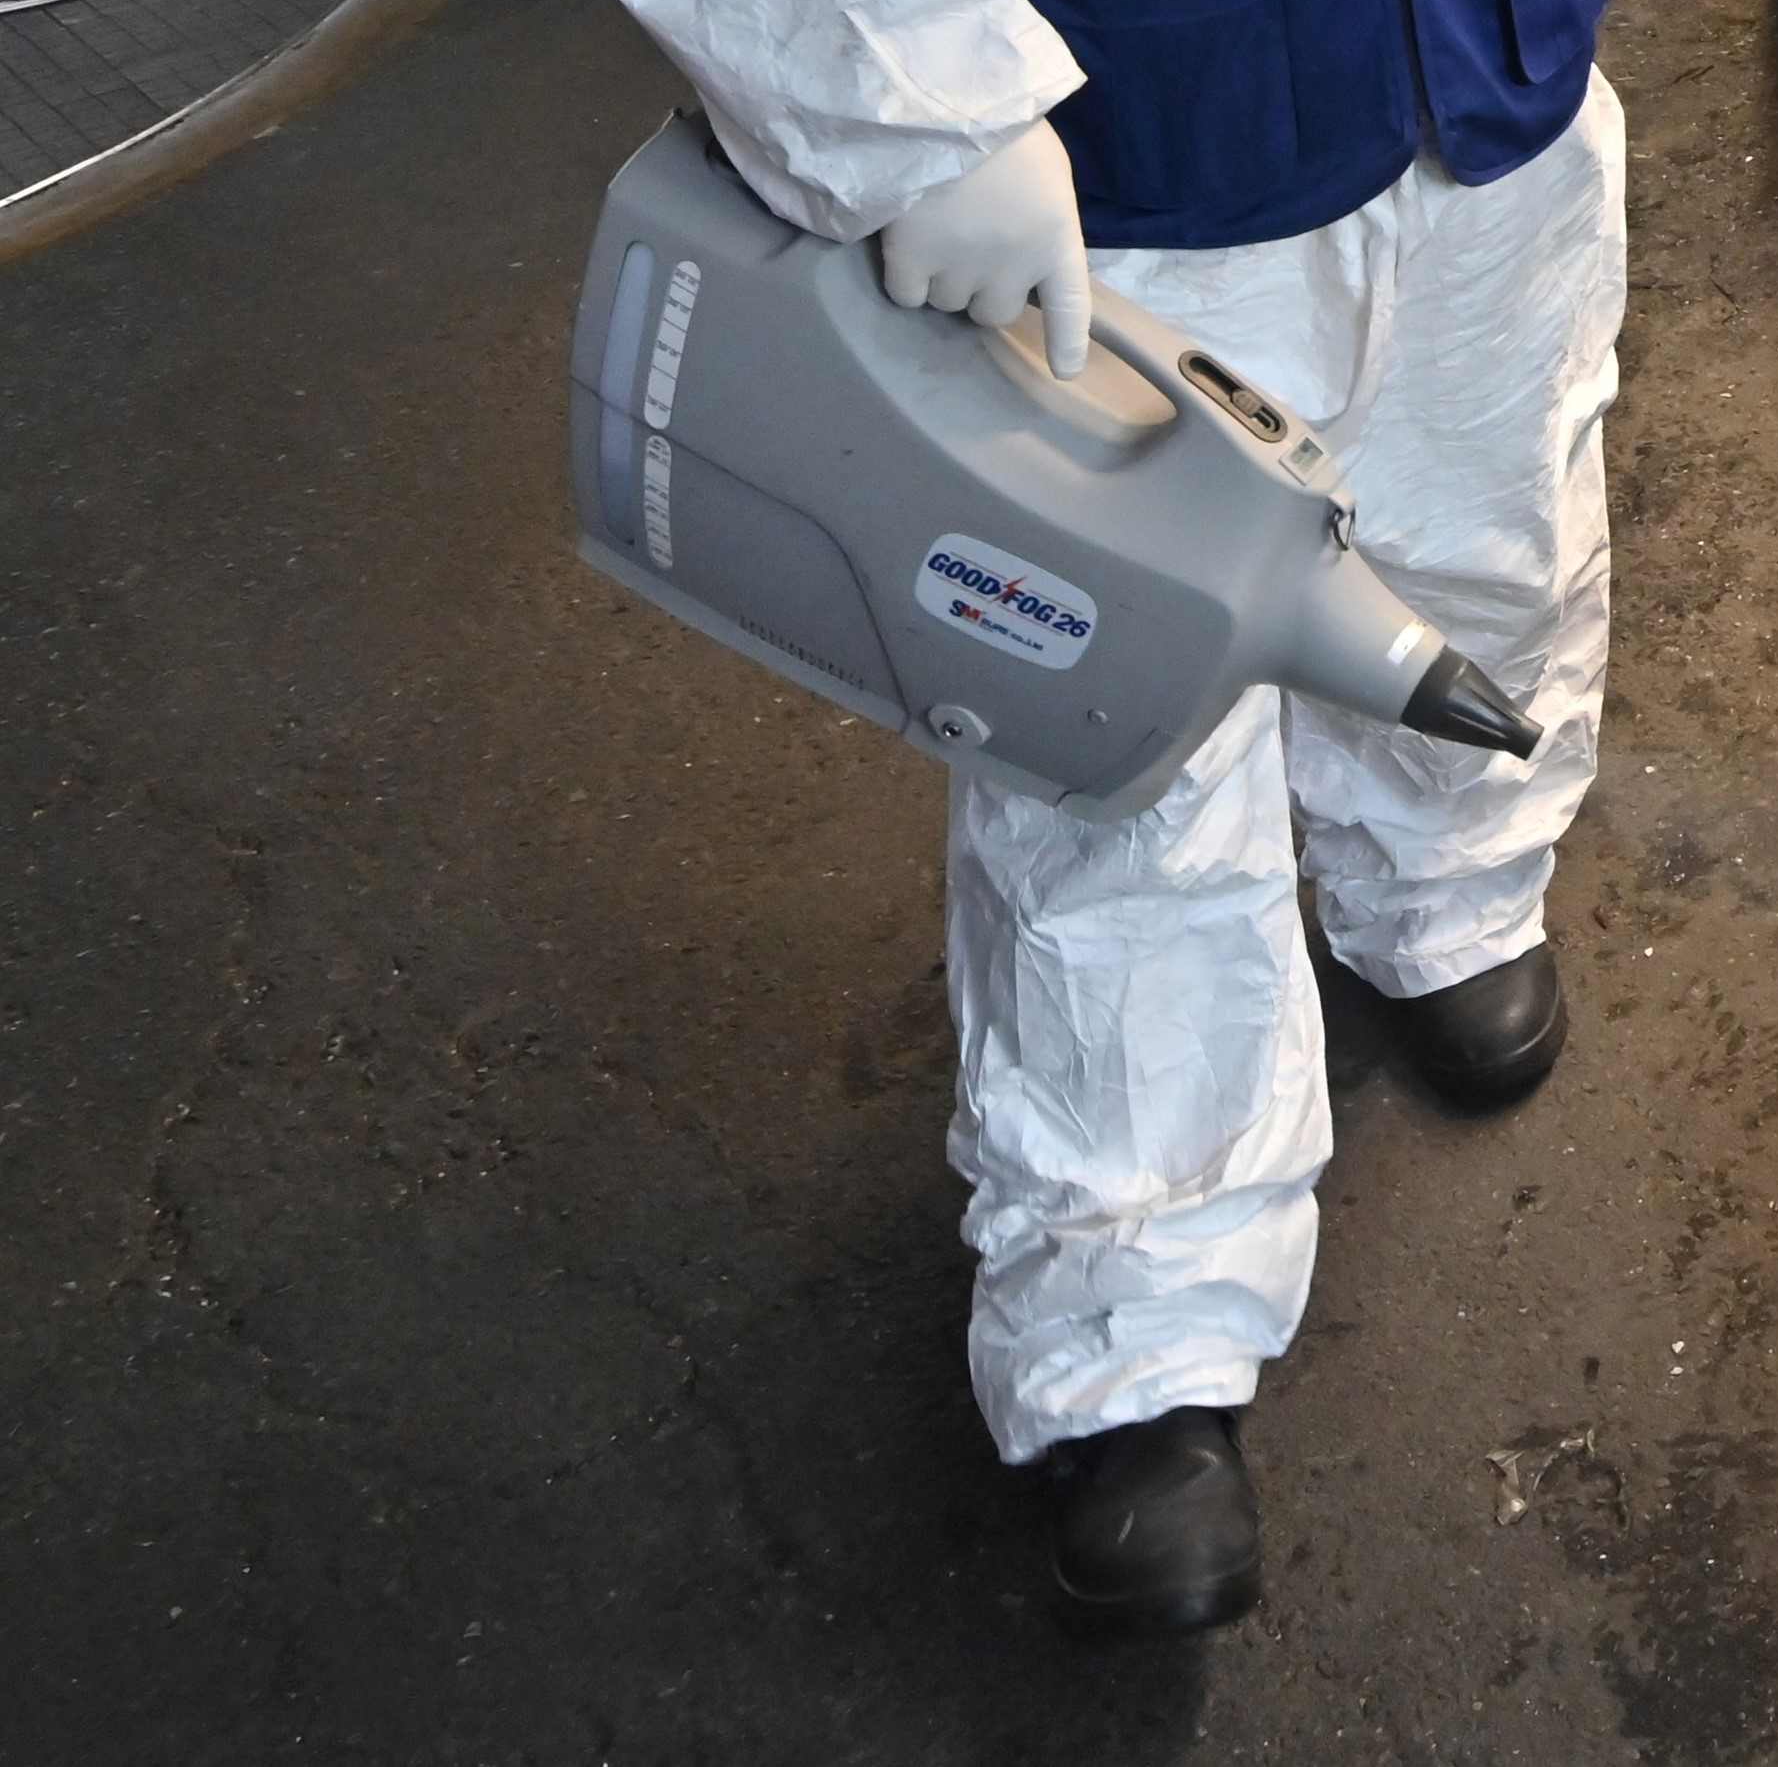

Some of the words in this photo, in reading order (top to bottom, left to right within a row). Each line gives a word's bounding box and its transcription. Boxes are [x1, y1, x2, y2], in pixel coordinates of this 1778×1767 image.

[928, 553, 1001, 595] GOOD
[1001, 588, 1056, 623] FOG
[1053, 613, 1090, 638] 26
